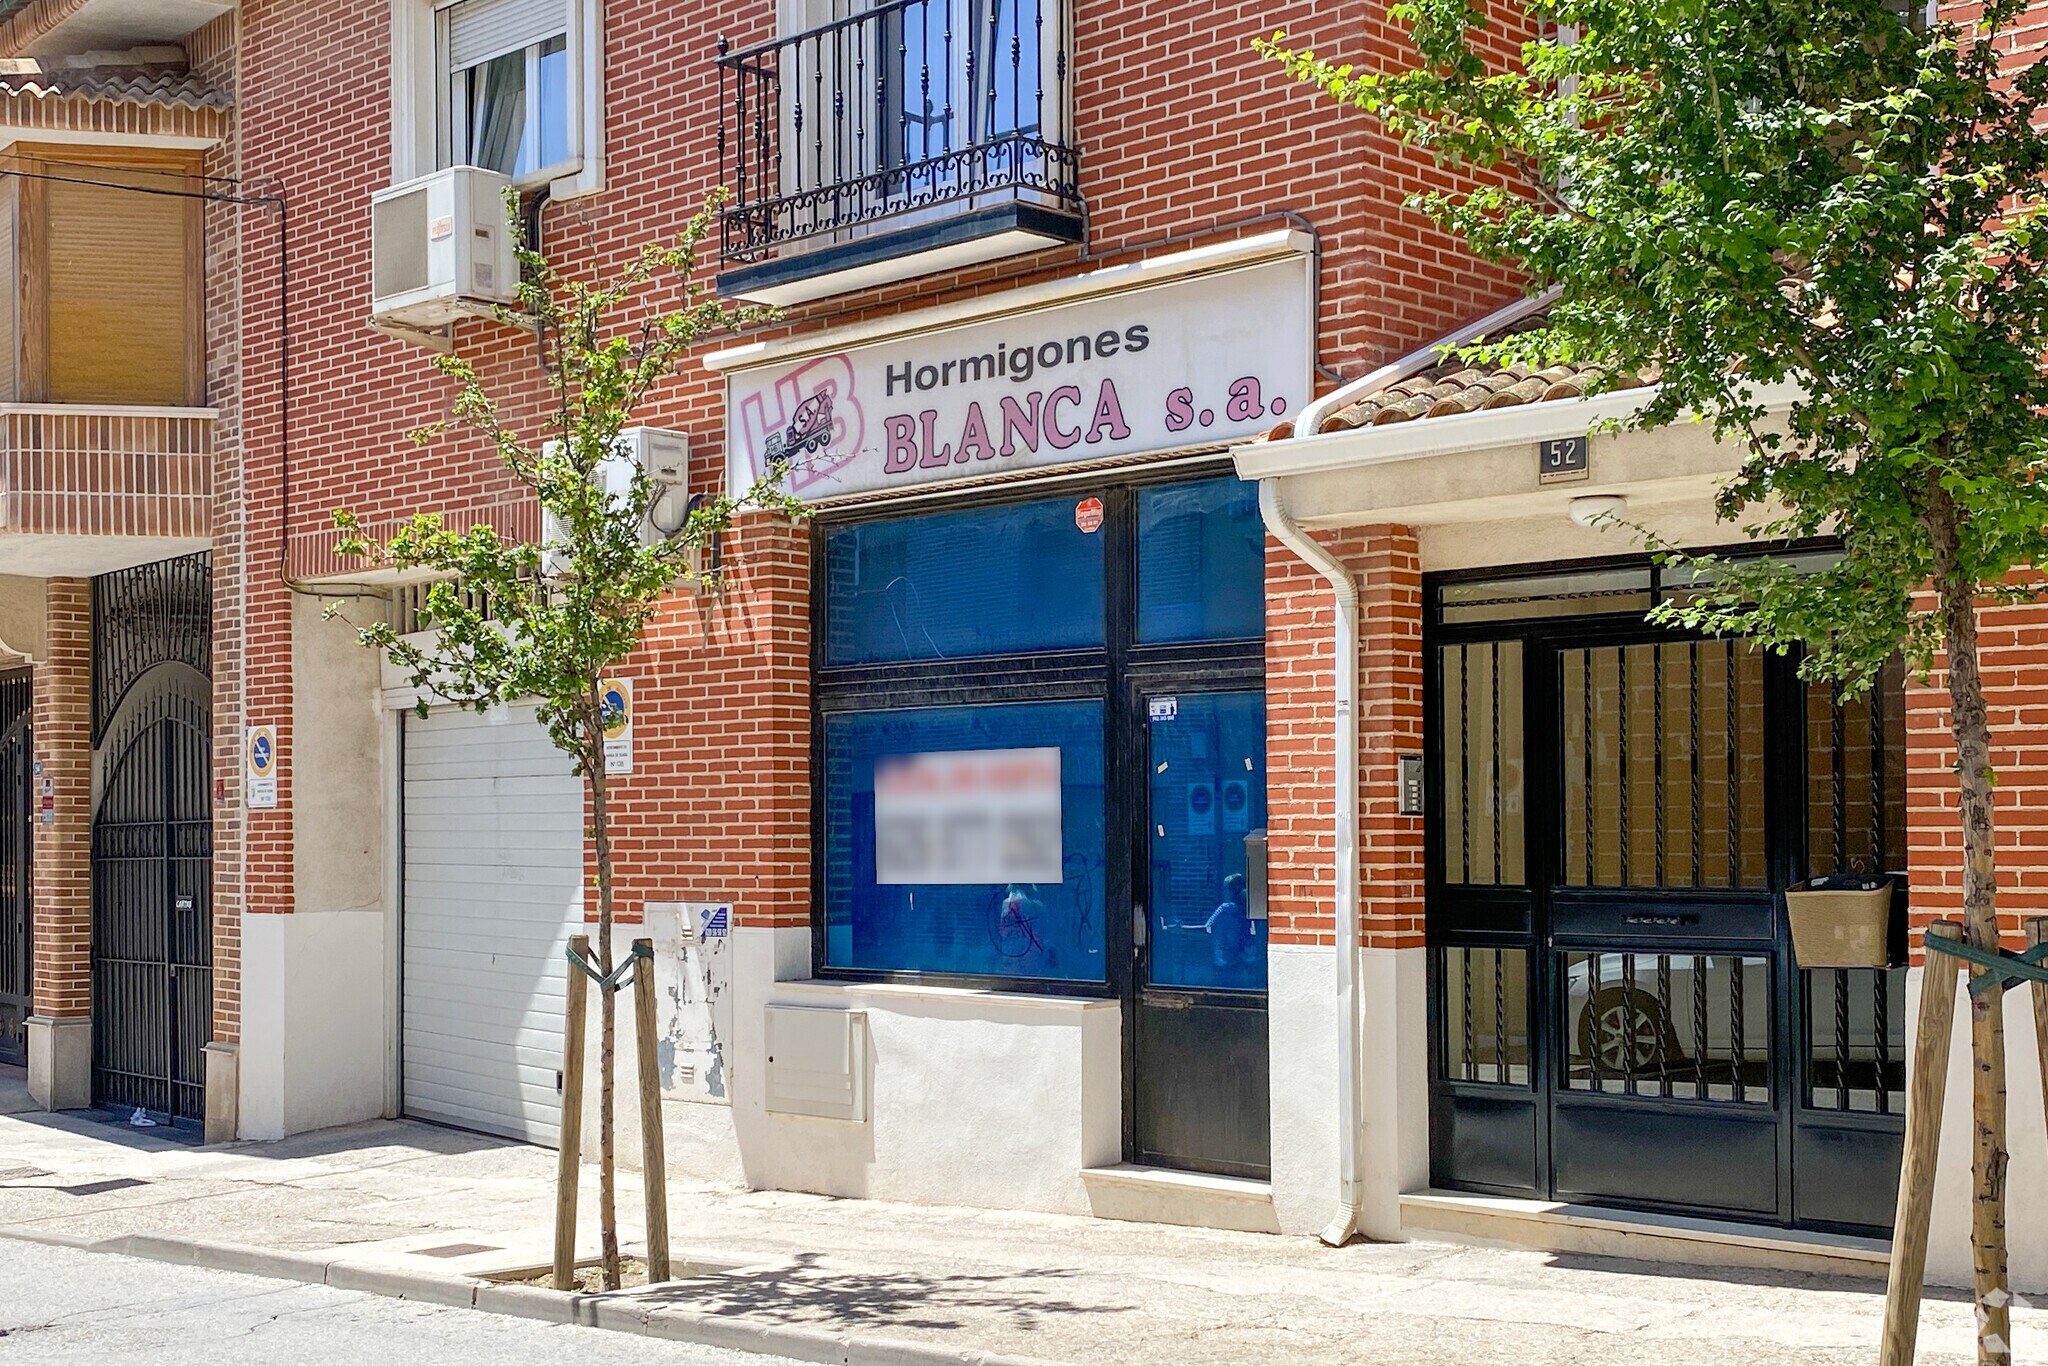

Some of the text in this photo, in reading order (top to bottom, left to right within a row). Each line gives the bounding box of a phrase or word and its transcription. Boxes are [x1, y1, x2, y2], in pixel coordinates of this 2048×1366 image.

[886, 324, 1150, 397] Hormigones
[883, 378, 1131, 475] BLANCA
[1551, 439, 1576, 466] 52
